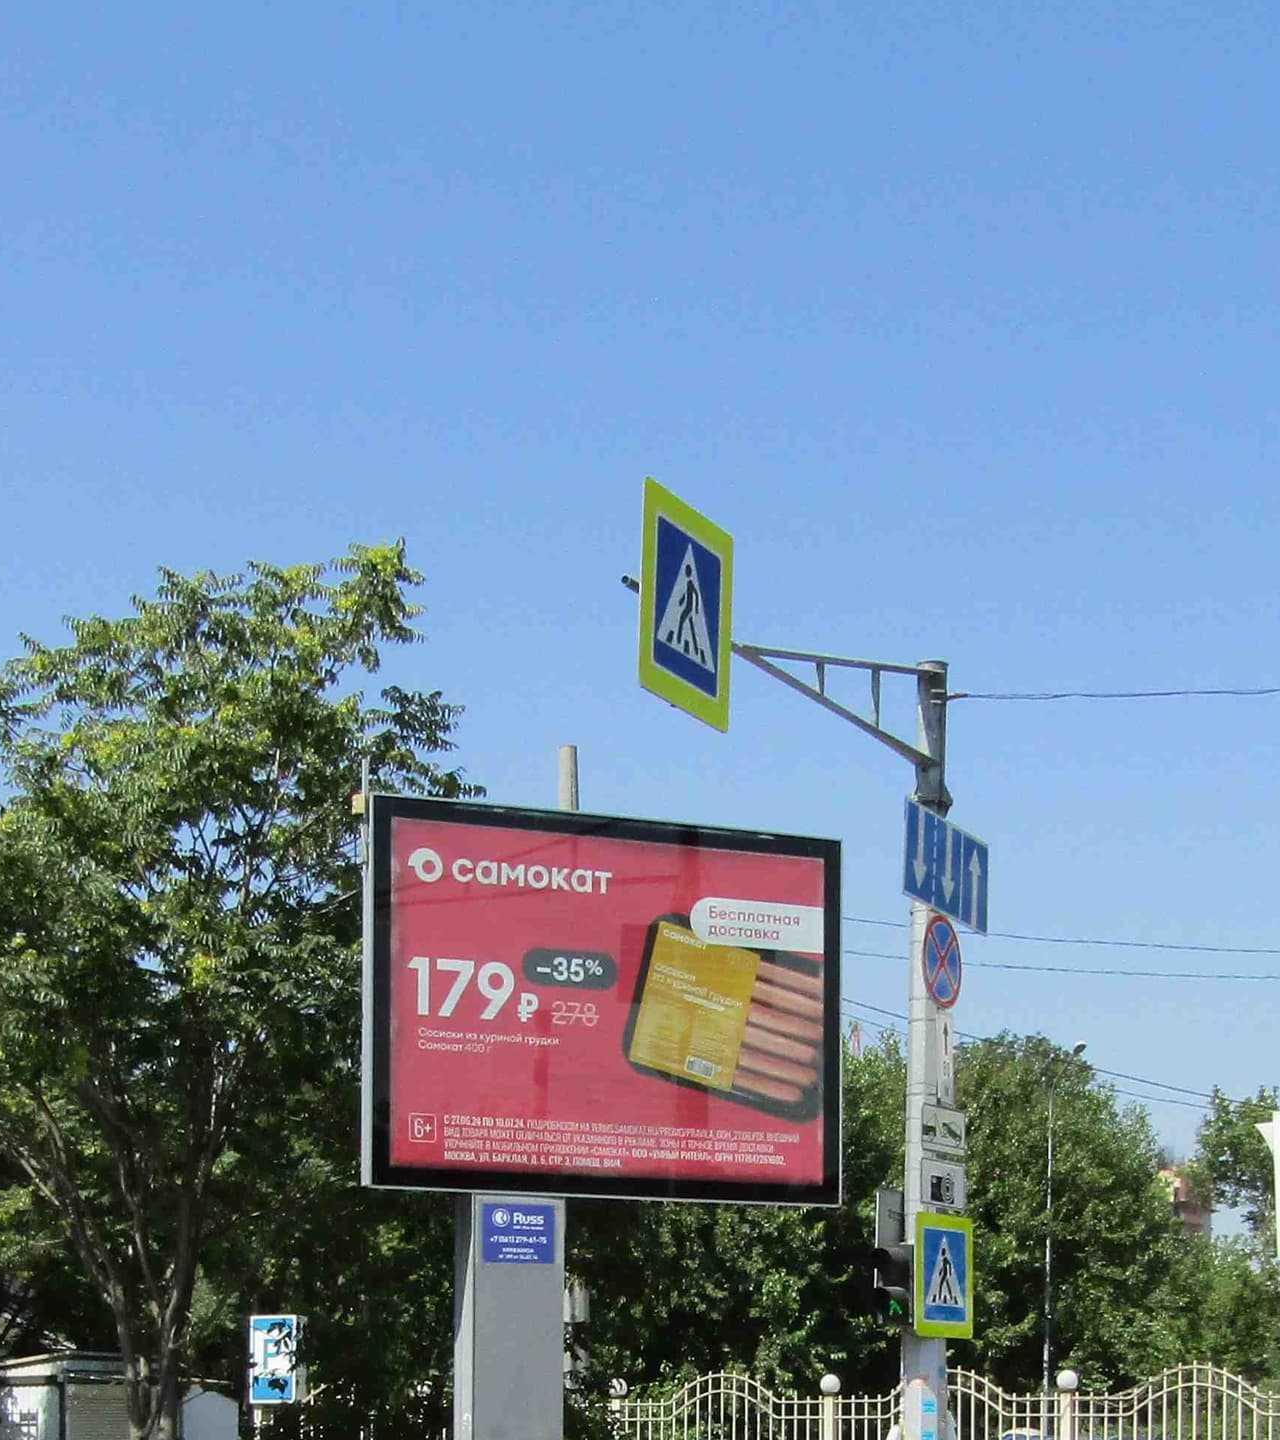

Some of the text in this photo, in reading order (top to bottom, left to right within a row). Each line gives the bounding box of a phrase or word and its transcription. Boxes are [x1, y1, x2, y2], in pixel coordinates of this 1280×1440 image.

[452, 858, 612, 894] самокат
[708, 905, 800, 927] Бесплатная
[708, 924, 780, 941] доставка
[536, 957, 603, 982] -35%
[418, 1027, 560, 1046] Сосиски из куриной грудки
[418, 1040, 463, 1051] Самокат
[414, 1118, 432, 1138] 6+
[513, 1212, 544, 1225] Russ
